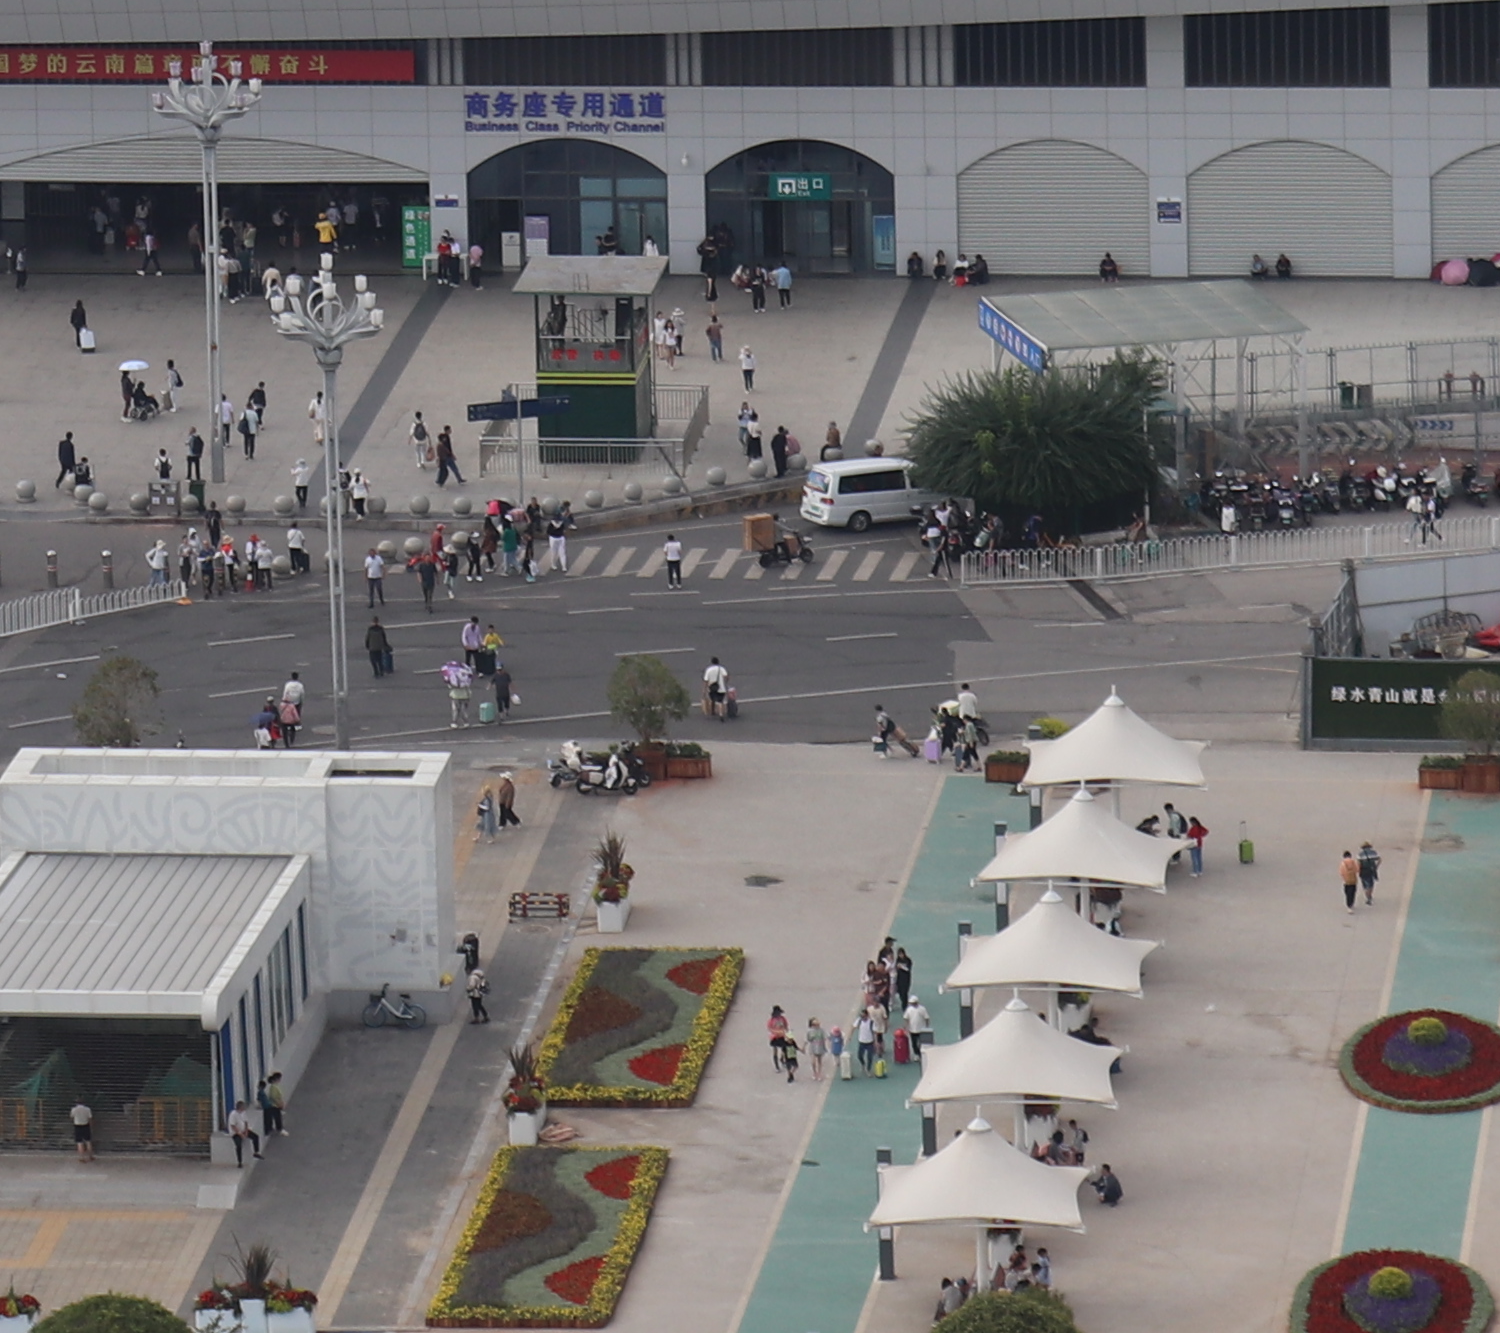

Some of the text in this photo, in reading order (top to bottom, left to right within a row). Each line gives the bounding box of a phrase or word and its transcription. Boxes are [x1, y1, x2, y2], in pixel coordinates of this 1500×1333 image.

[463, 90, 666, 118] 商务座专用通道
[465, 121, 665, 134] Business Class Priority Channel
[797, 177, 824, 190] 出口
